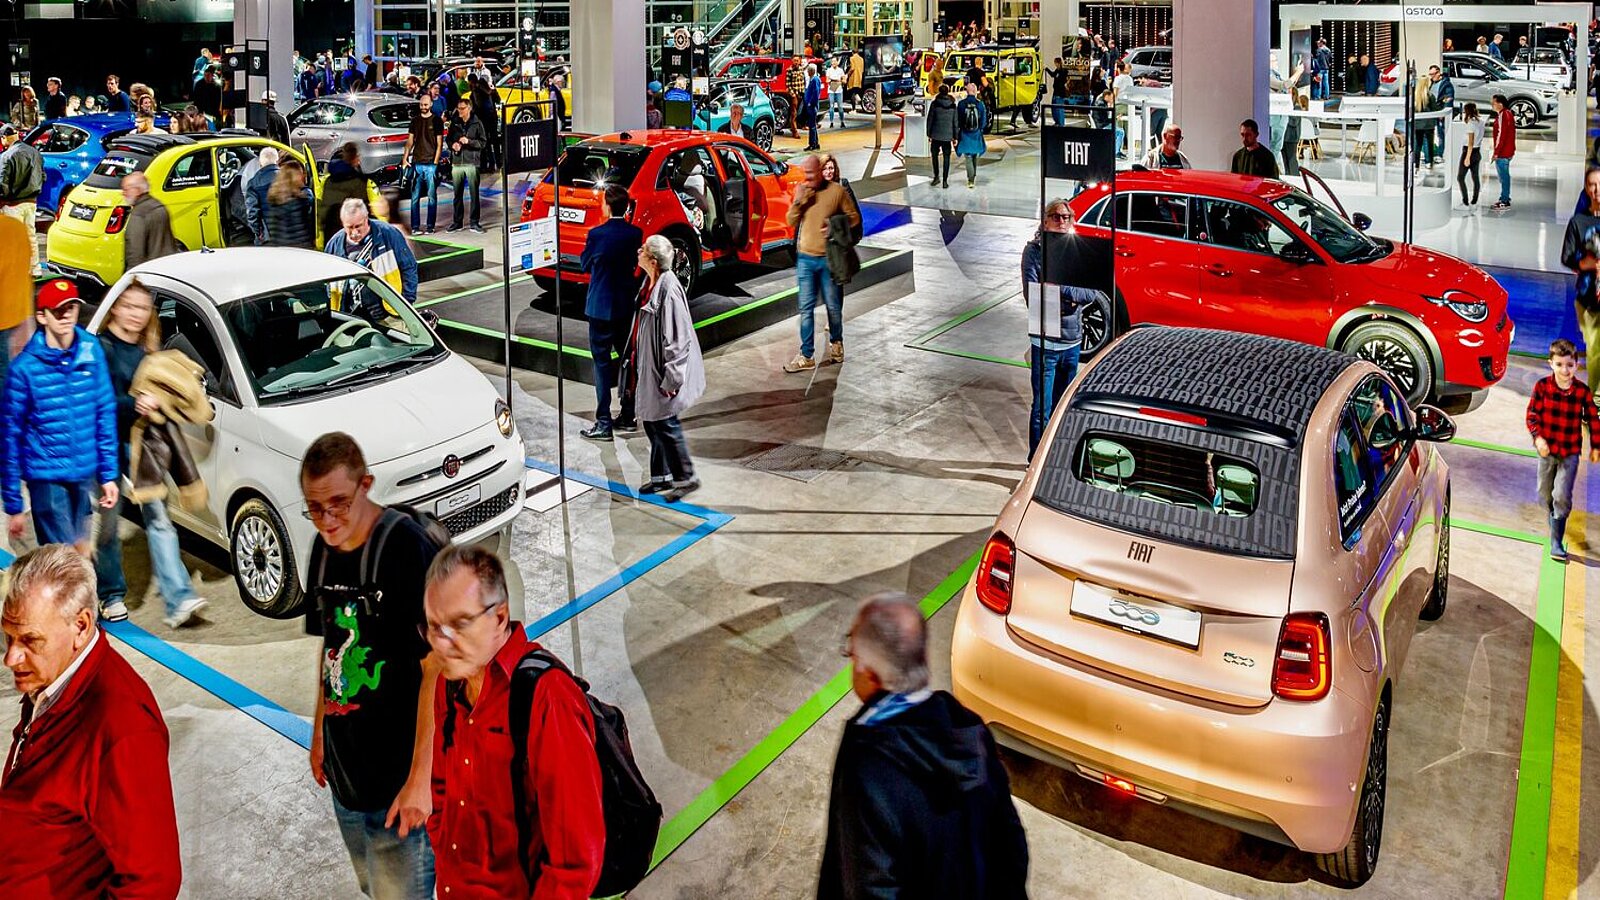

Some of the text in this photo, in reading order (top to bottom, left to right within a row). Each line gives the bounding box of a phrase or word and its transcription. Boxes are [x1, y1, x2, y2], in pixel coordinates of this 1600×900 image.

[671, 55, 681, 65] FIAT
[520, 134, 540, 158] FIAT
[1064, 141, 1090, 166] FIAT
[1127, 541, 1156, 564] FIAT
